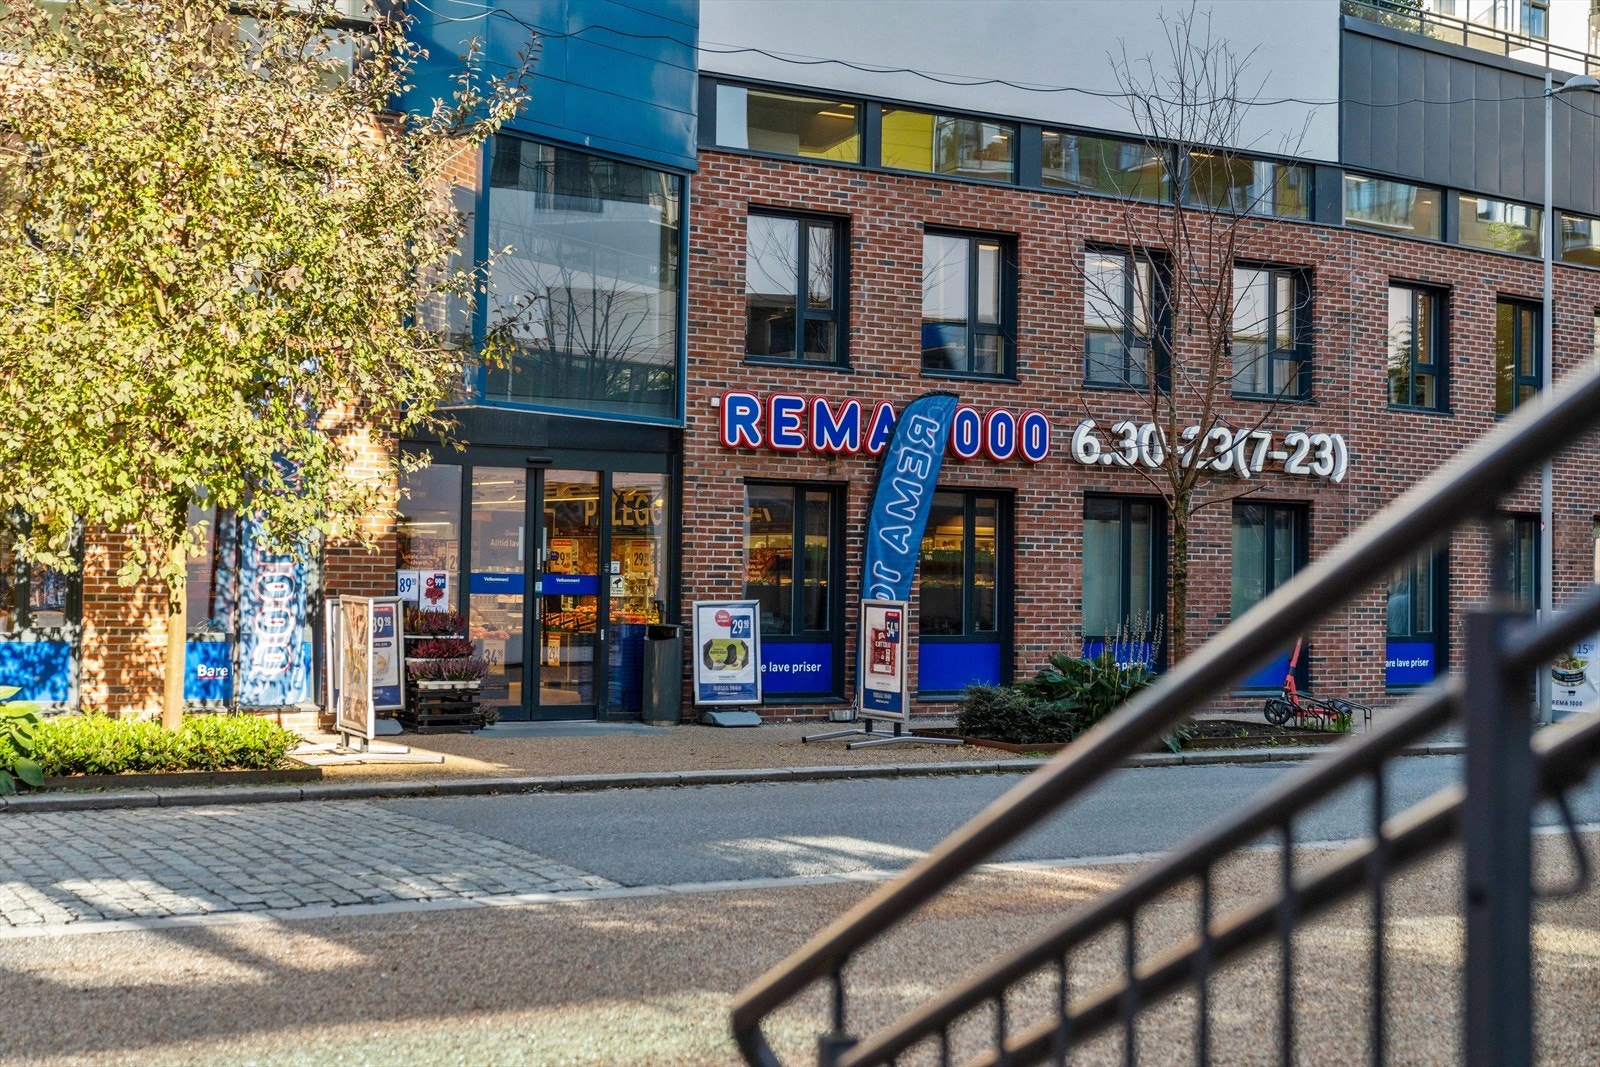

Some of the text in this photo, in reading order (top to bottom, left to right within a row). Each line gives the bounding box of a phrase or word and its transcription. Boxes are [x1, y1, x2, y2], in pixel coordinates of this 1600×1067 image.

[719, 390, 1051, 463] REMA 000
[585, 491, 661, 526] PLEGG
[634, 553, 644, 566] 29
[399, 578, 411, 593] 89
[732, 619, 743, 634] 29
[886, 621, 895, 638] 54
[197, 664, 228, 677] Bare
[769, 661, 790, 672] lave
[792, 661, 821, 674] priser
[1396, 658, 1410, 668] lave
[1410, 657, 1430, 669] priser
